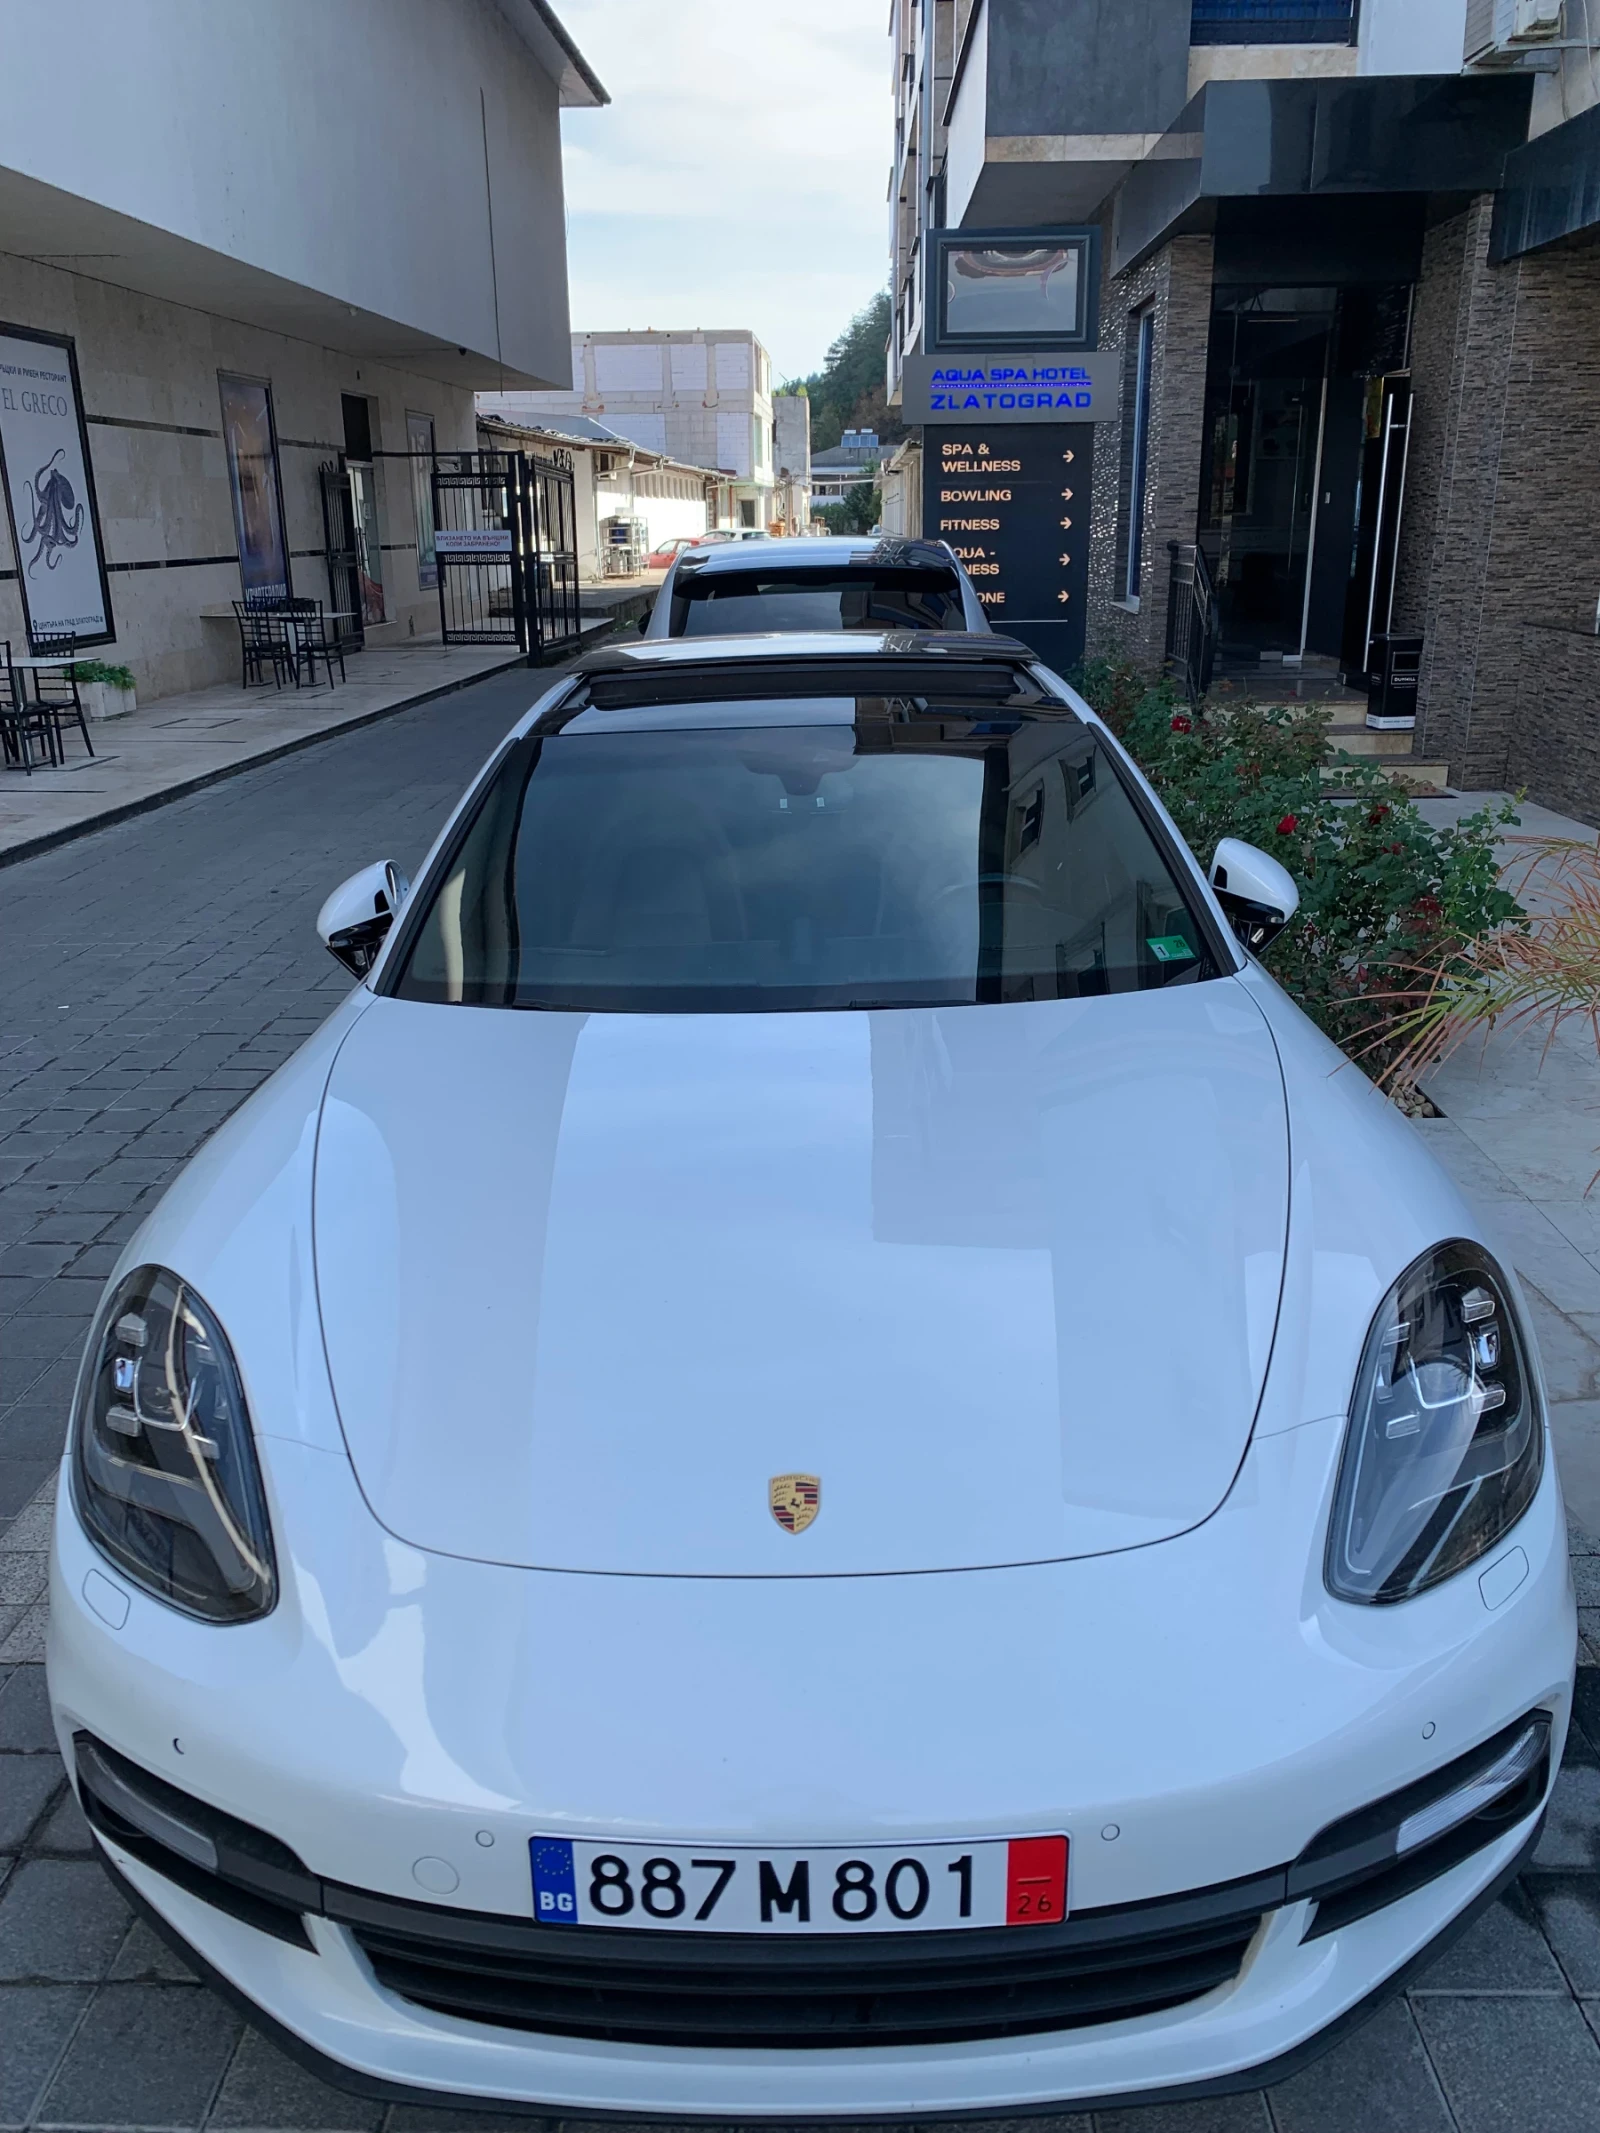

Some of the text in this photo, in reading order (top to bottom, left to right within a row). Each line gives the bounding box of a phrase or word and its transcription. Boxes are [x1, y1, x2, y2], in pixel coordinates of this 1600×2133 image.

[932, 367, 1092, 382] AQUA SPA HOTEL
[1, 387, 68, 417] EL GRECO
[930, 392, 1092, 410] ZLATOGRAD
[941, 443, 990, 456] SPA &
[941, 460, 1021, 473] WELLNESS
[940, 489, 1012, 502] BOWLING
[940, 519, 1000, 531] FITNESS
[953, 547, 986, 559] QUA
[963, 563, 1000, 575] NESS
[976, 592, 1005, 603] ONE
[1157, 946, 1166, 956] 1
[589, 1854, 973, 1923] 887 M 801
[540, 1891, 574, 1912] BG
[1016, 1892, 1053, 1915] 26
